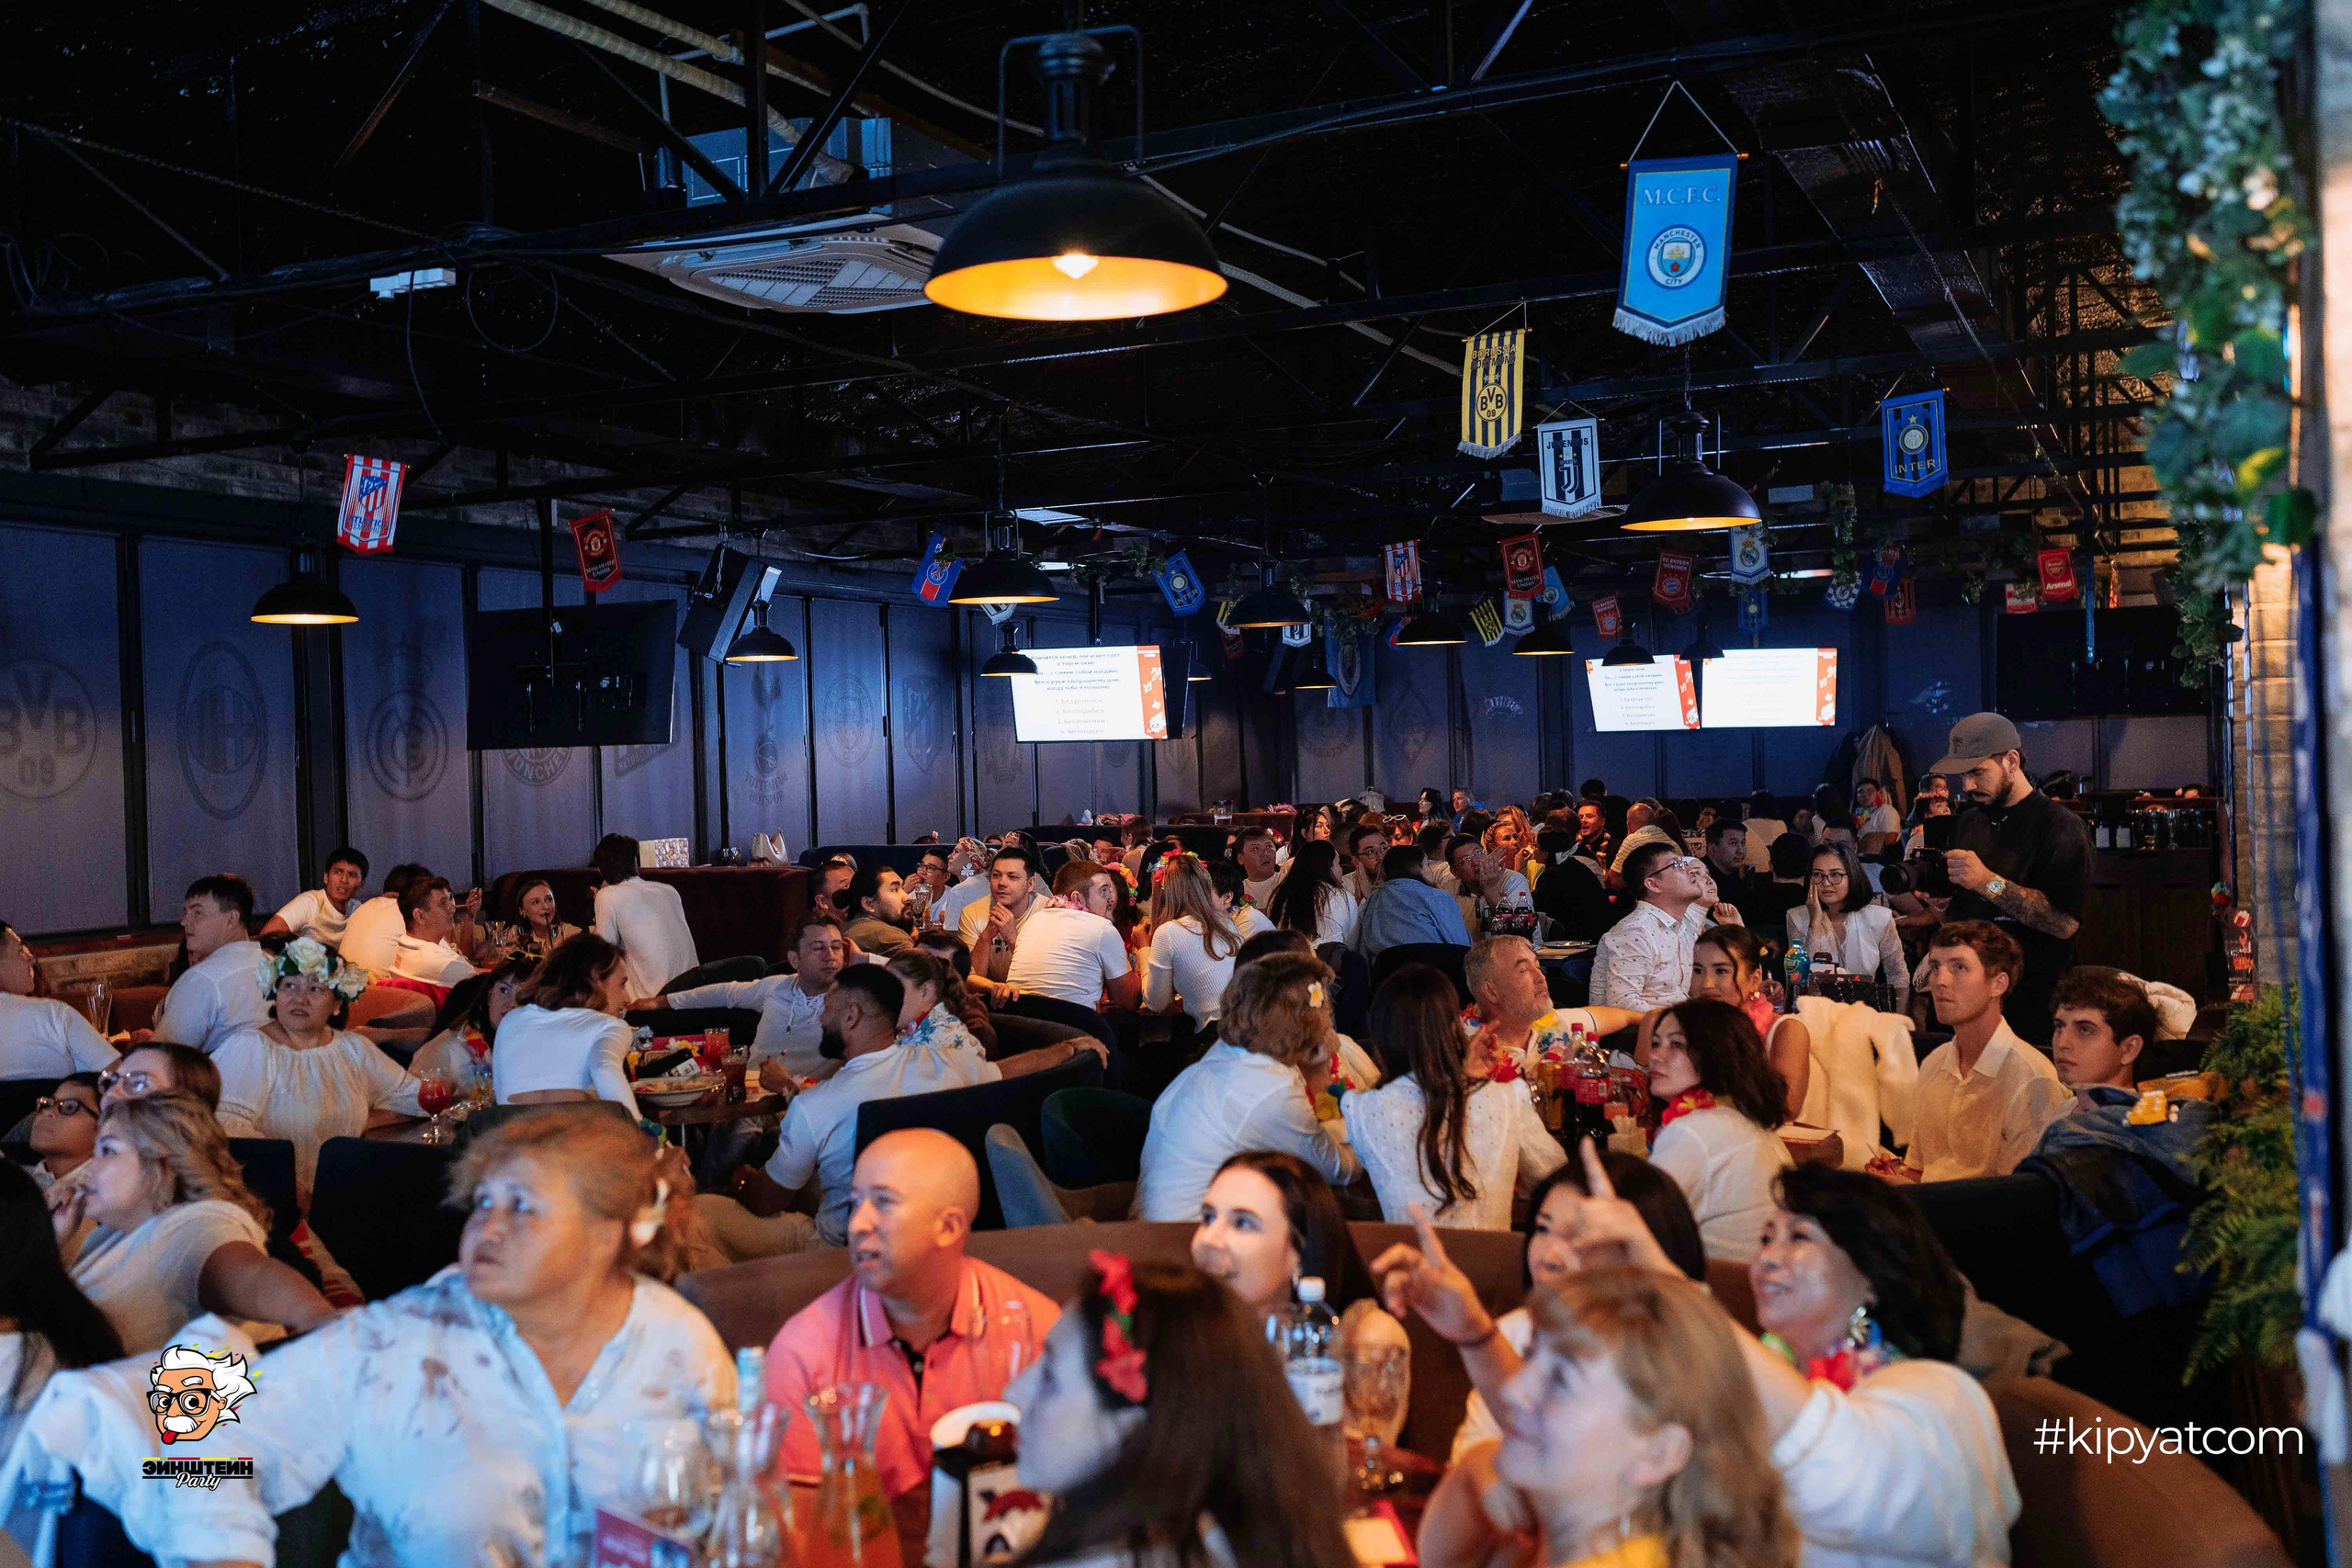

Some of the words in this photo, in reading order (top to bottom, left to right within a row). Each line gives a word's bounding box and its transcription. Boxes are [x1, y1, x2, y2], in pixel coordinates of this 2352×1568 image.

[1642, 186, 1722, 205] M.C.F.C.
[1654, 230, 1702, 250] MANCHESTER
[1472, 344, 1516, 359] BORUSSIA
[1471, 355, 1516, 370] DORTMUND
[1480, 387, 1504, 412] BVB
[1487, 409, 1497, 418] 09
[1546, 438, 1589, 449] JUVENTUS
[1894, 459, 1936, 475] INTER
[2046, 580, 2073, 591] Arsenal
[1175, 589, 1198, 605] INTER
[18, 757, 56, 786] 09
